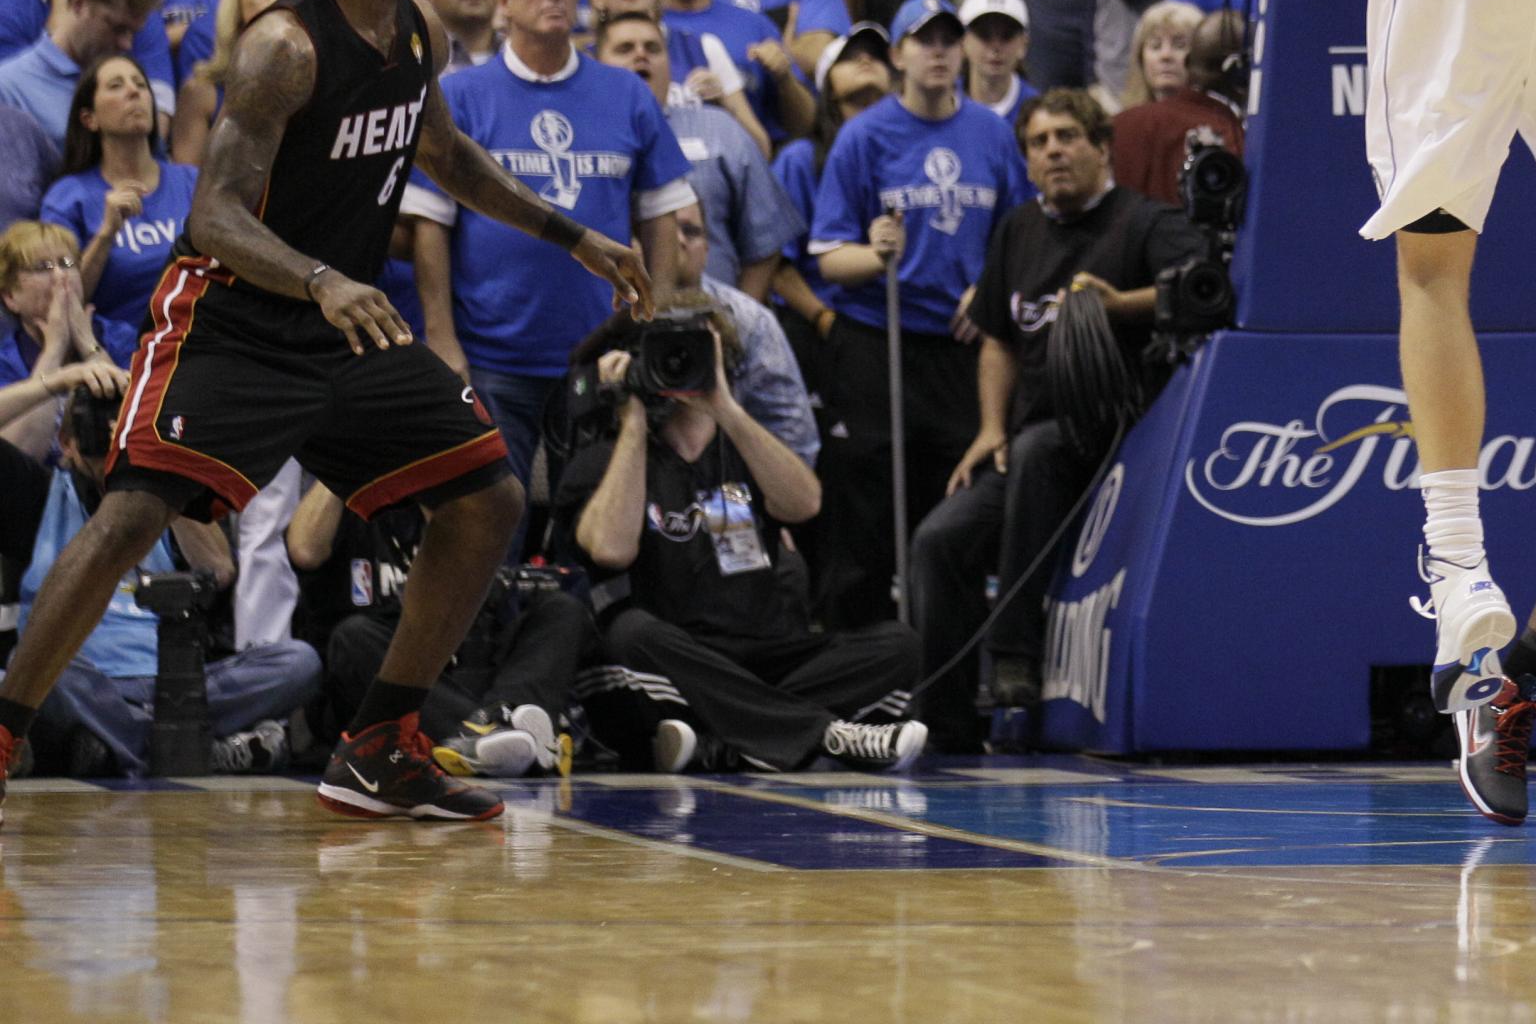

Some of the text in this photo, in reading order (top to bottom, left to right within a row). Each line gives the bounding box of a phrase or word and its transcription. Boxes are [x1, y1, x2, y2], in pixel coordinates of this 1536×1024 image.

[330, 83, 427, 160] HEAT
[377, 156, 405, 206] 6
[1203, 419, 1338, 491] The
